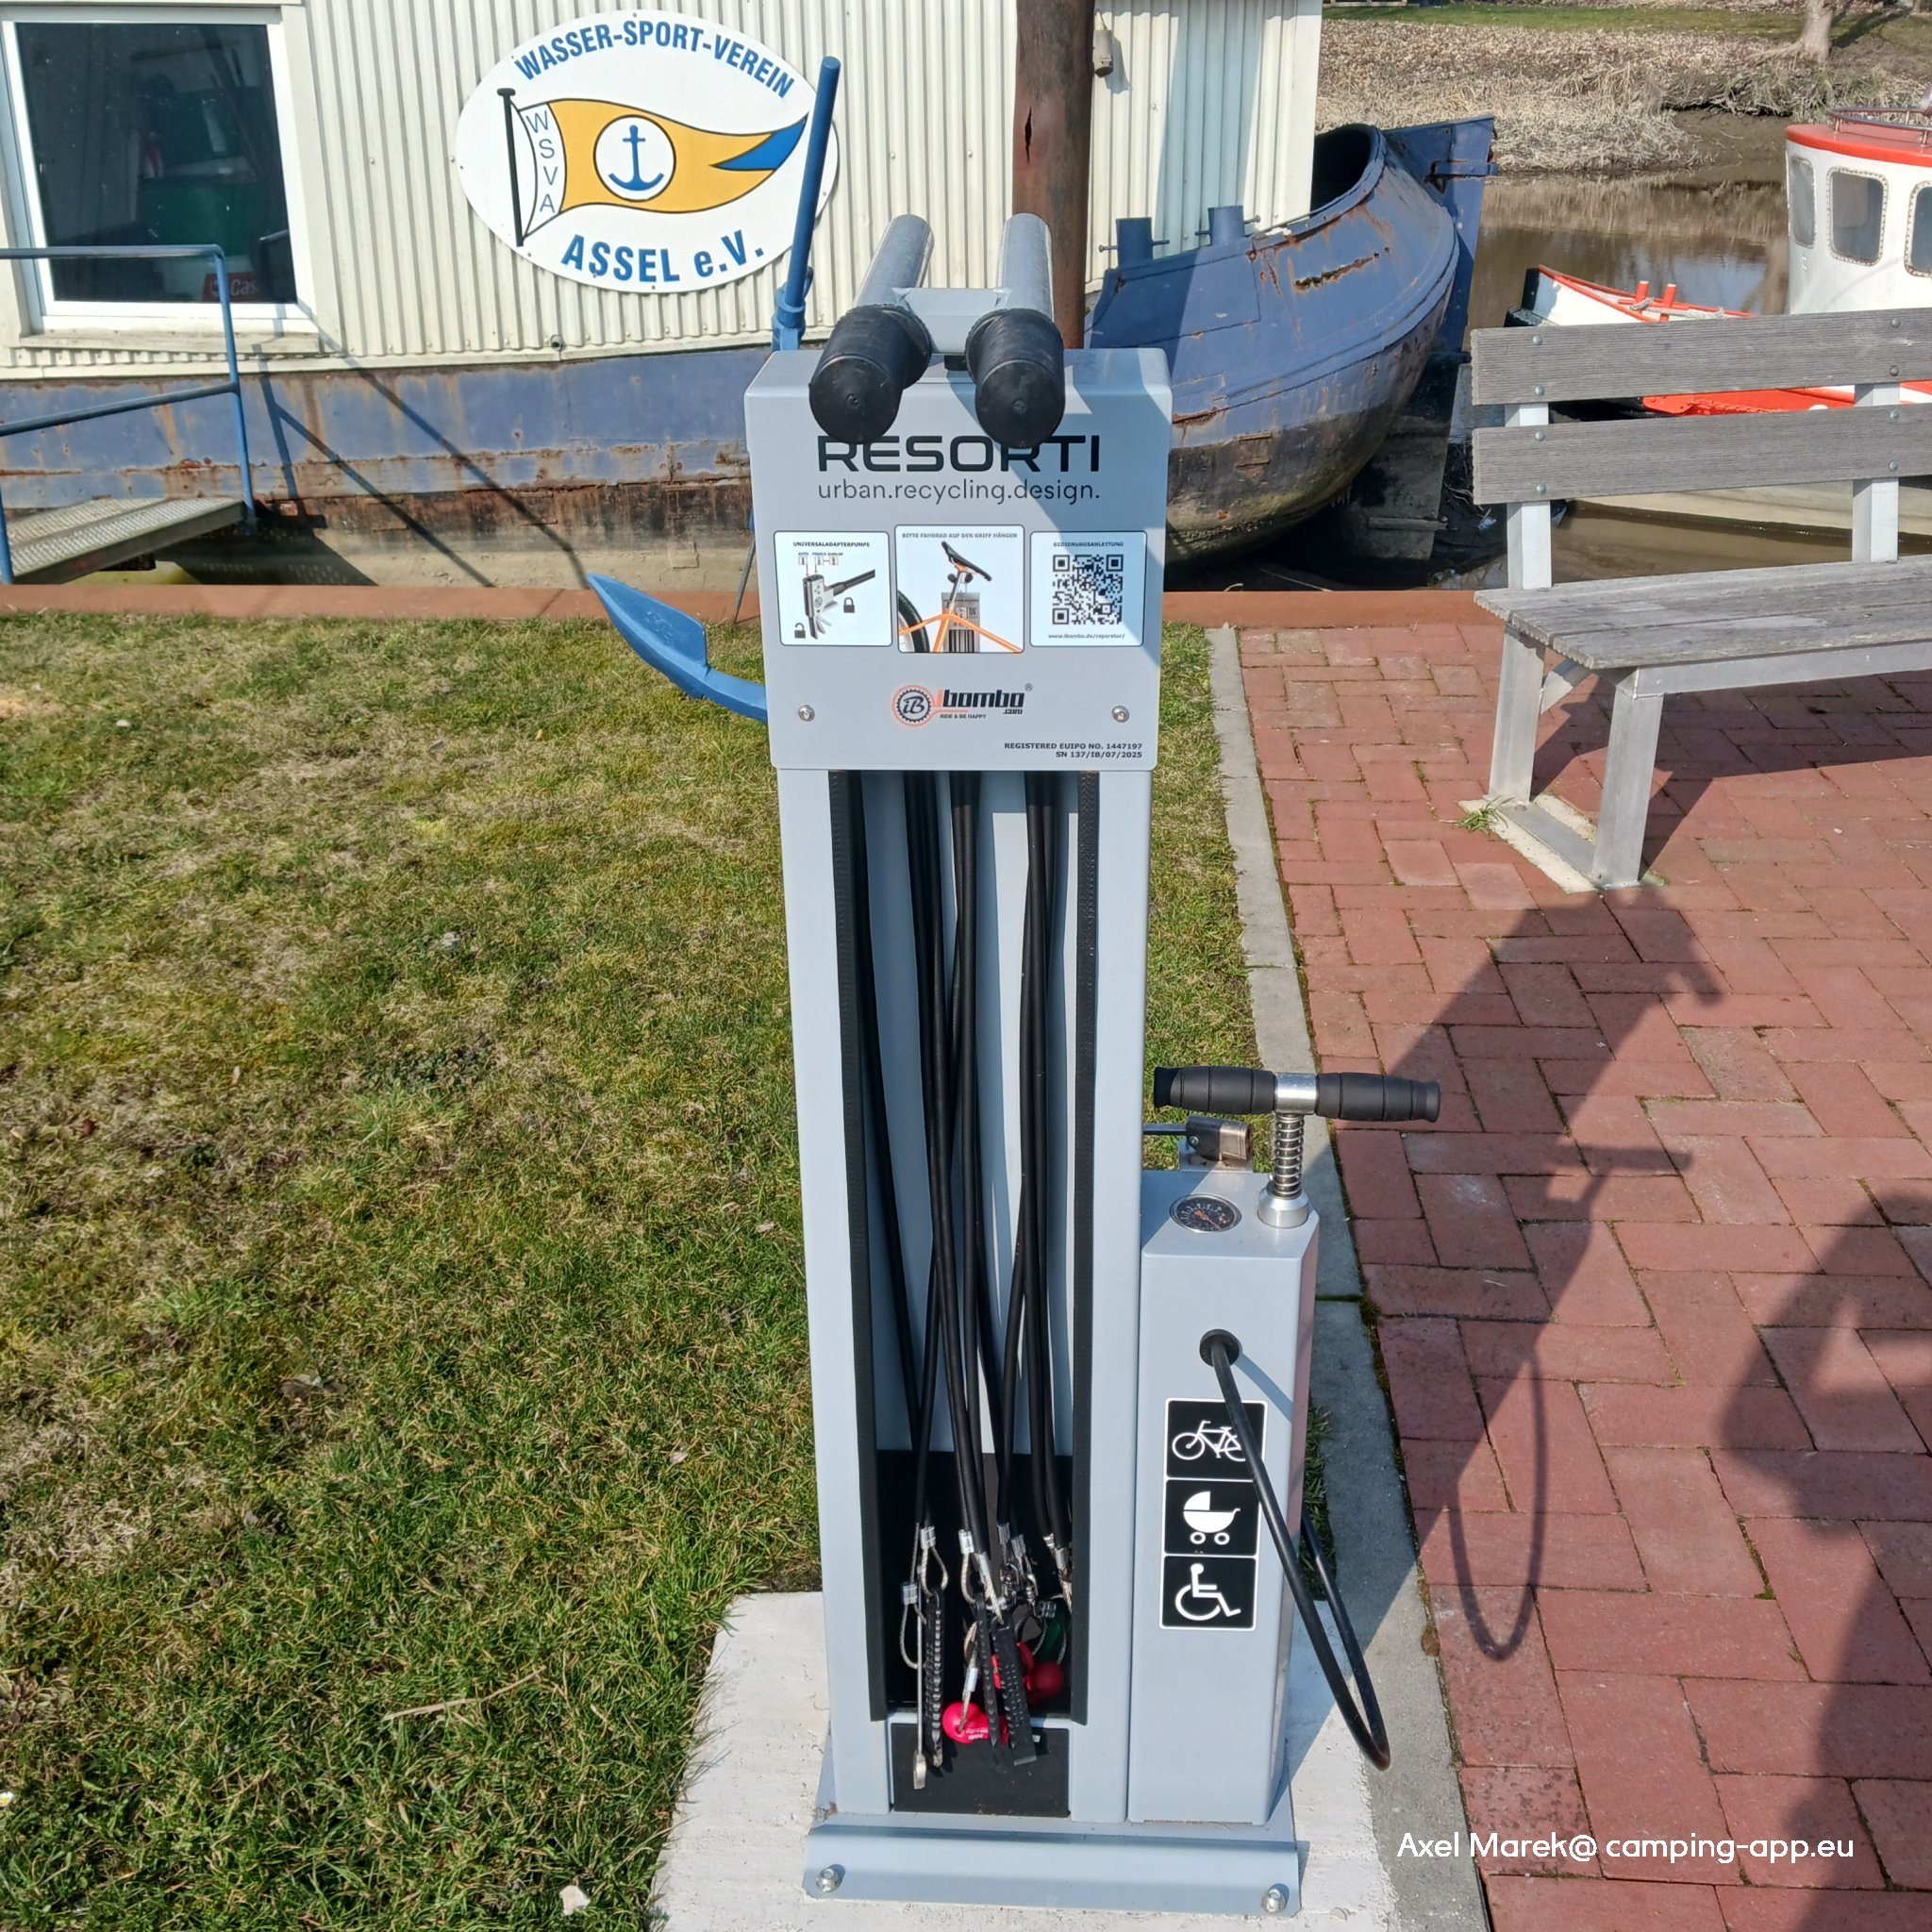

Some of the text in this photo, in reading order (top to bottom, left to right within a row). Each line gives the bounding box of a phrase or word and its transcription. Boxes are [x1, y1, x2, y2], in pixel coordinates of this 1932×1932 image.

[515, 21, 794, 98] WASSER-SPORT-VEREIN
[561, 229, 764, 283] ASSEL e.V.
[818, 435, 1100, 472] RESORTI
[818, 478, 1101, 506] urban.recycling.design.
